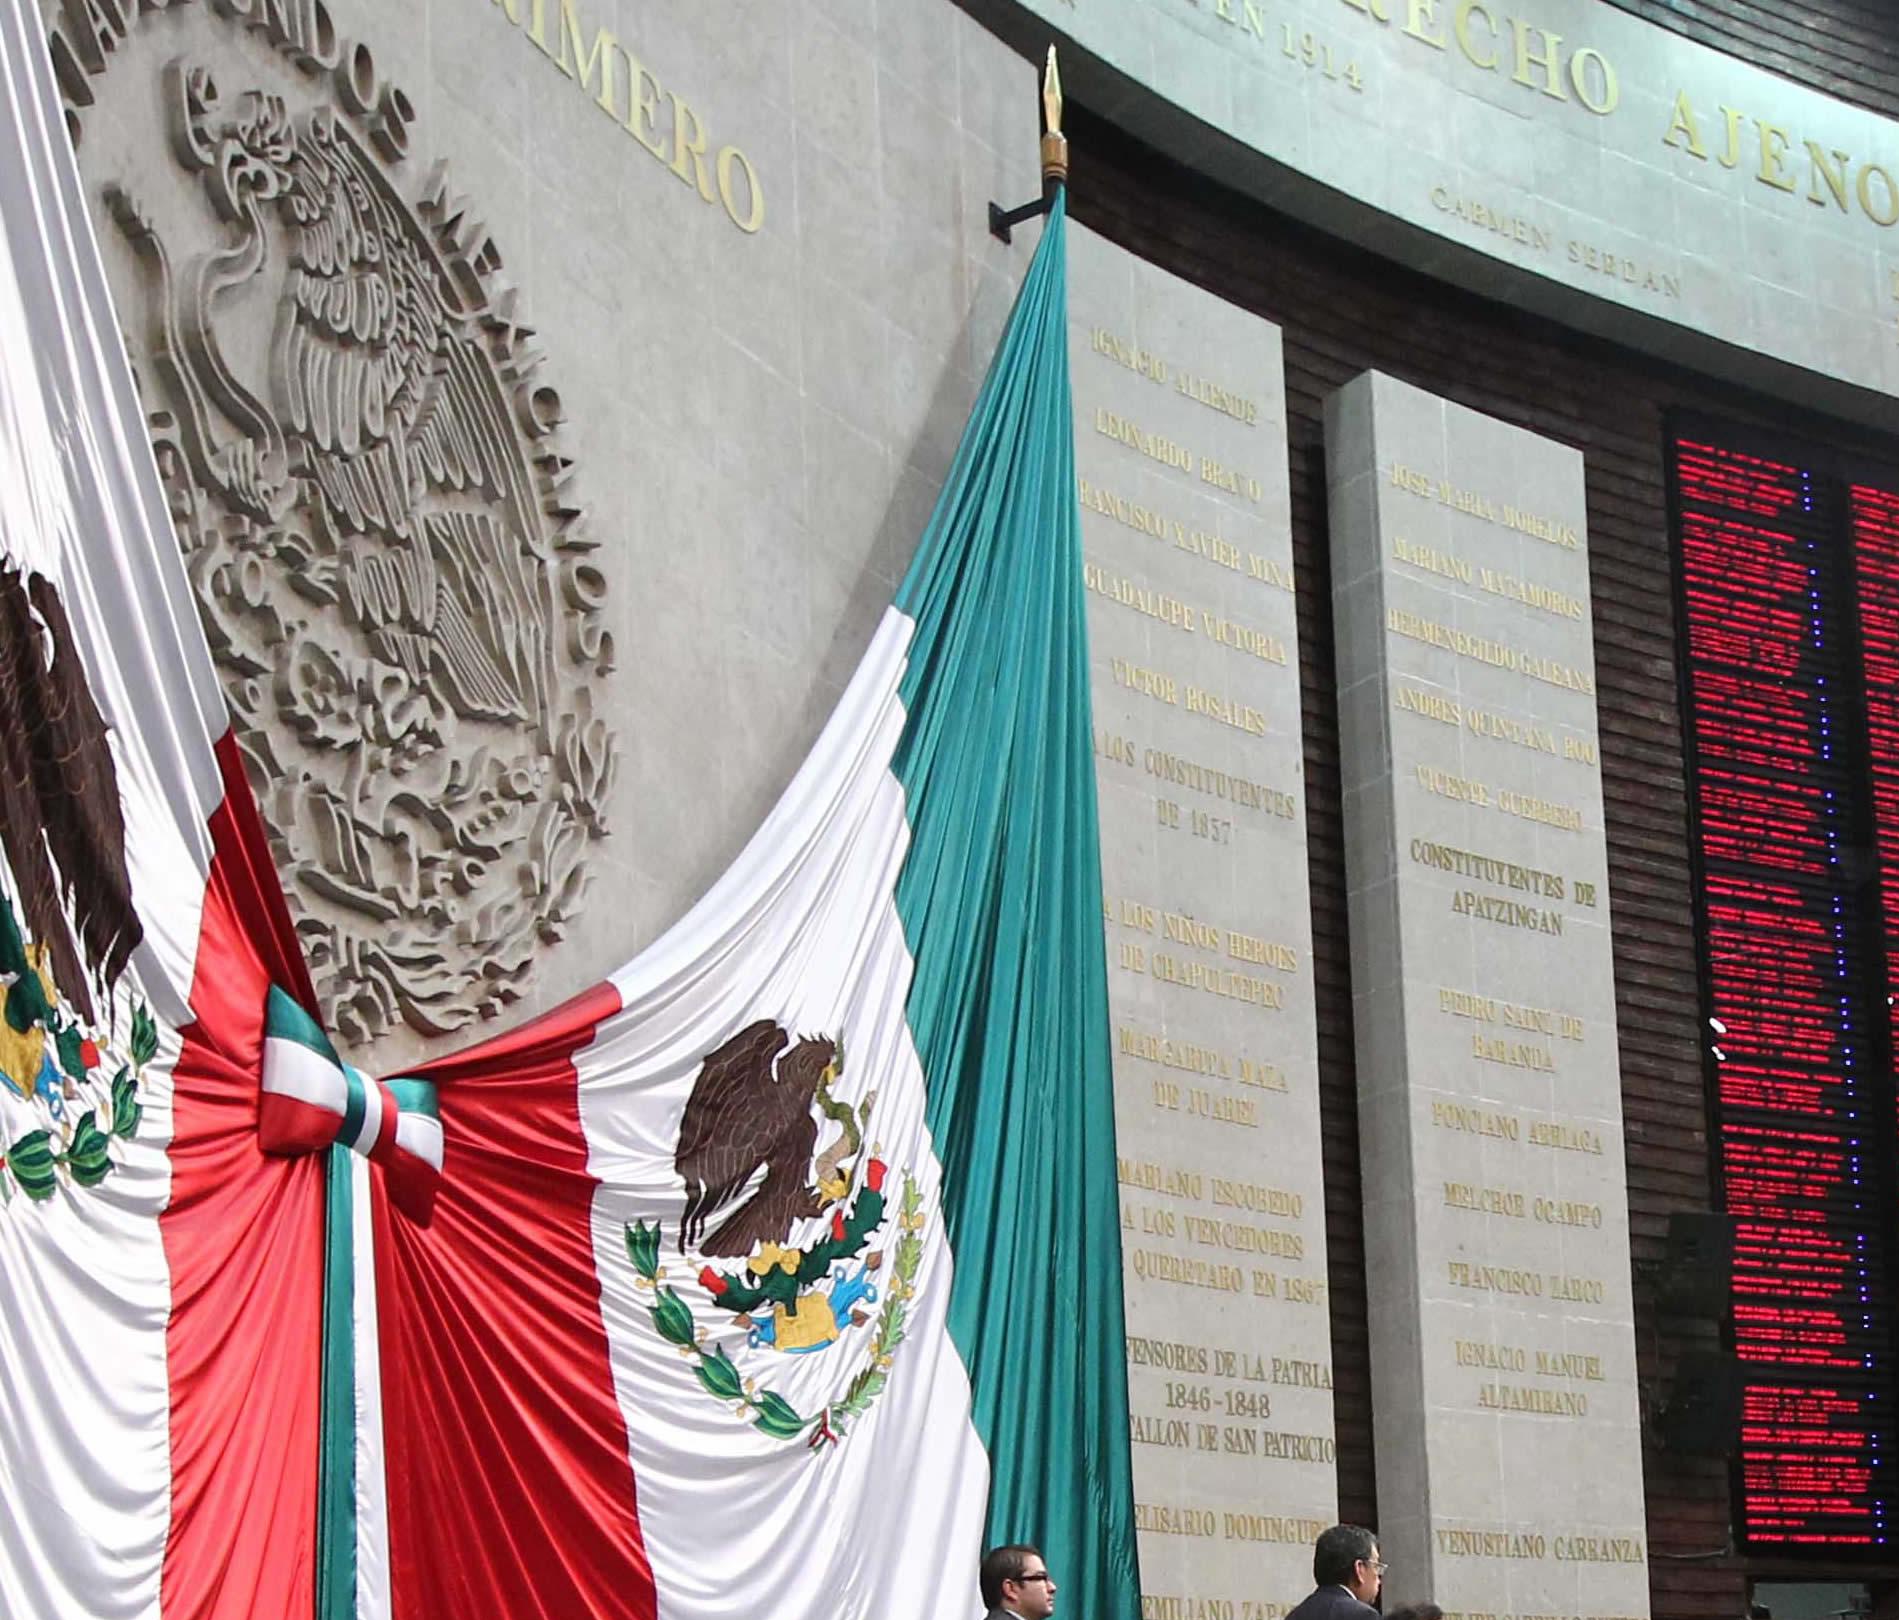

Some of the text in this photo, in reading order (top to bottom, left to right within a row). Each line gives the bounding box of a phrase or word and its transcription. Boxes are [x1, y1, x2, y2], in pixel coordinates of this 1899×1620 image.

[1281, 22, 1364, 94] 1914
[1340, 0, 1618, 117] ECHO
[488, 0, 766, 235] IMERO
[1430, 186, 1683, 300] CARMEN SERDAN
[1090, 326, 1168, 386] IGNACIO
[1095, 406, 1193, 475] LEONARDO
[1391, 462, 1577, 552] JOSE MARIA MORELOS
[1173, 519, 1241, 571] XAVIER
[1247, 552, 1297, 593] MINA
[1391, 535, 1583, 622] MARIANO MATAMOROS
[1083, 562, 1288, 667] GUADALUPE VICTORIA
[1386, 606, 1596, 697] HERMENEGILDO GALEANA
[1110, 655, 1267, 738] VICTOR ROSALES
[1393, 685, 1596, 767] ANDRES QUINTANA ROO
[1103, 729, 1136, 768] LOS
[1143, 747, 1297, 821] CONSTITUYENTES
[1415, 763, 1584, 834] VICENTE GUERRERO
[1156, 797, 1232, 845] DE 1857
[1409, 838, 1597, 908] CONSTITUYENTES DE
[1120, 899, 1154, 935] LOS
[1162, 910, 1219, 950] NIÑOS
[1226, 930, 1299, 974] HEROES
[1451, 889, 1563, 937] APATZINGAN
[1120, 943, 1284, 1011] DE CHAPULTEPEC
[1439, 988, 1498, 1023] PEDRO
[1560, 1015, 1586, 1042] DE
[1153, 1079, 1180, 1111] DE
[1431, 1100, 1520, 1143] PONCIANO
[1117, 1158, 1304, 1220] MARIANO ESCOBEDO
[1443, 1181, 1604, 1231] MELCHOR OCAMPO
[1122, 1203, 1304, 1262] A LOS VENCEDORES
[1132, 1248, 1243, 1294] QUERETARO
[1251, 1270, 1277, 1299] EN
[1447, 1260, 1605, 1306] FRANCISCO ZARCO
[1213, 1349, 1237, 1379] DE
[1243, 1352, 1267, 1383] LA
[1271, 1356, 1335, 1391] PATRIA
[1455, 1339, 1606, 1382] IGNACIO MANUEL
[1477, 1382, 1589, 1419] ALTAMIRANO
[1197, 1422, 1219, 1452] DE
[1223, 1426, 1258, 1456] SAN
[1263, 1430, 1337, 1466] PATRICIO
[1223, 1511, 1330, 1546] DOMINGUE
[1436, 1528, 1645, 1565] VENUSTIANO CARRANZA
